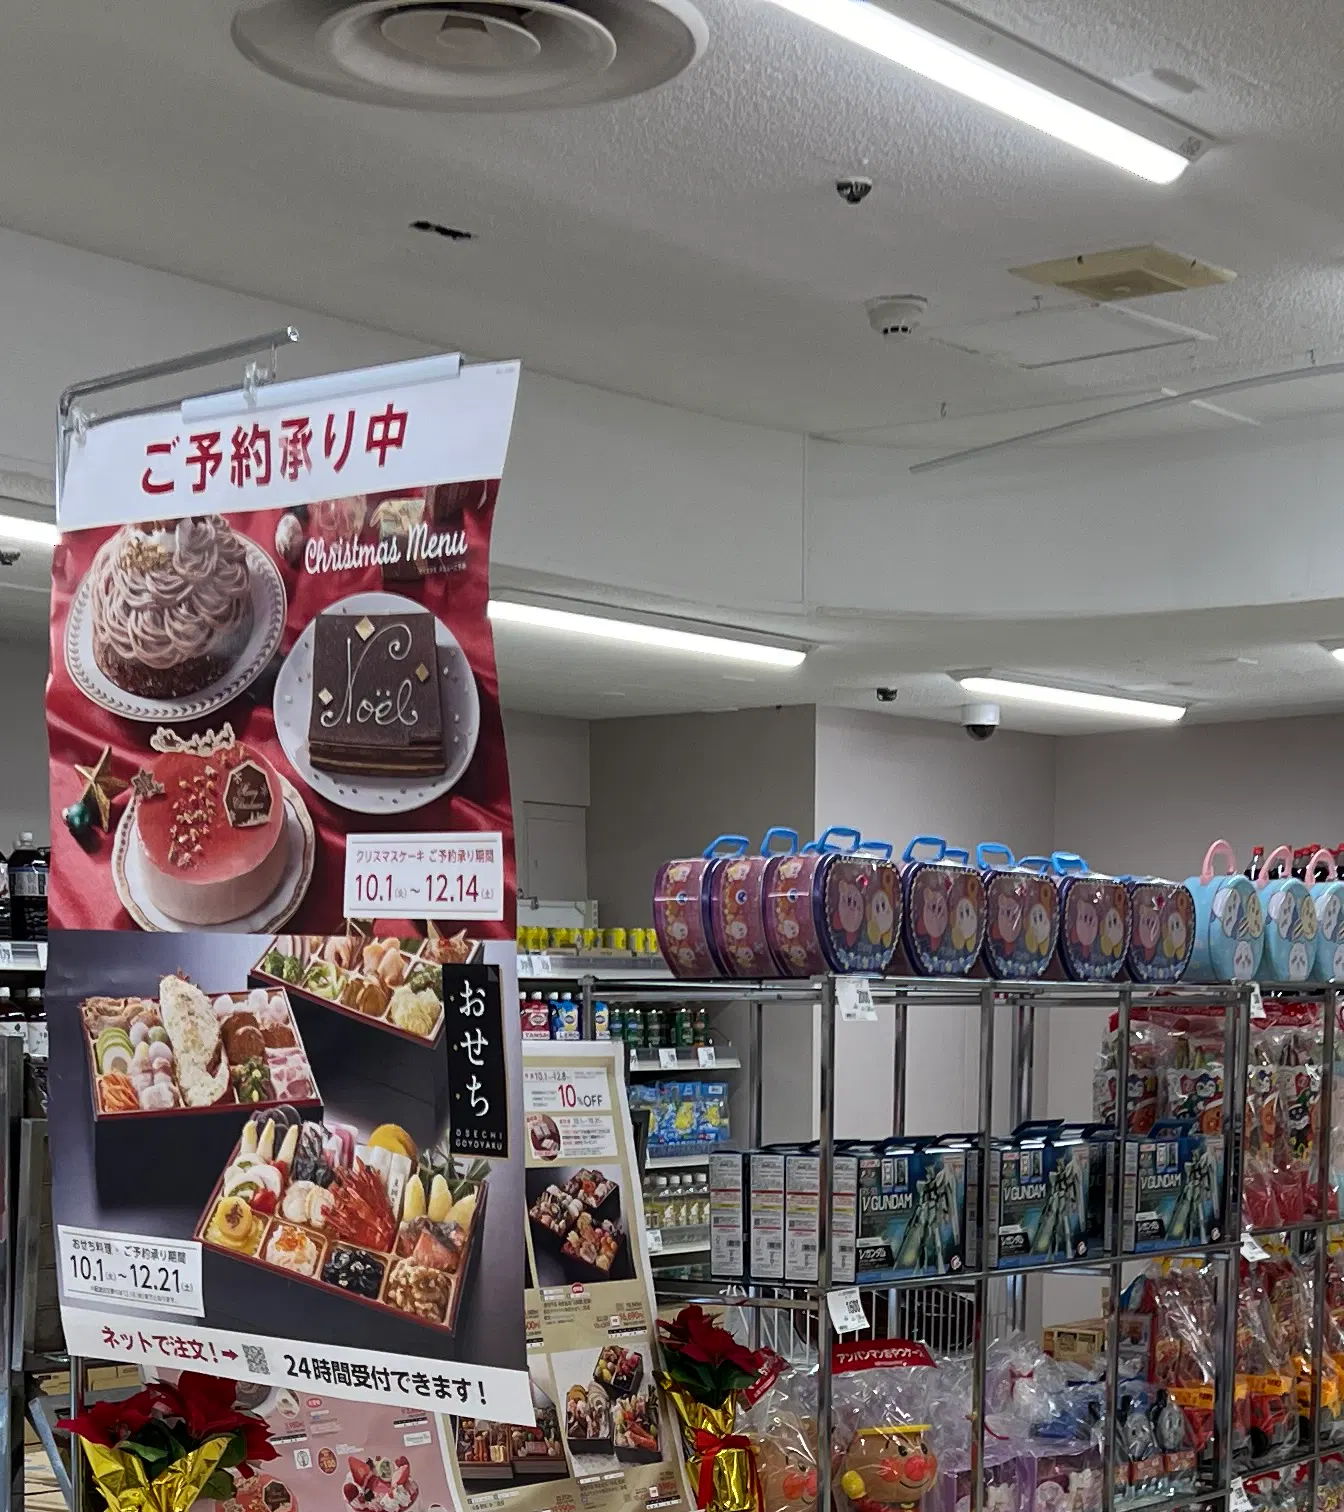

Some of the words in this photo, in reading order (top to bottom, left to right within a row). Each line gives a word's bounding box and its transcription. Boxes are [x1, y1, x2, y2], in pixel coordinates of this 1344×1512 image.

[140, 403, 409, 495] ご予約承り中
[305, 535, 401, 574] Christmas
[406, 521, 468, 562] Menu
[459, 979, 489, 1117] おせち
[283, 1353, 488, 1405] 24時間受付できます!
